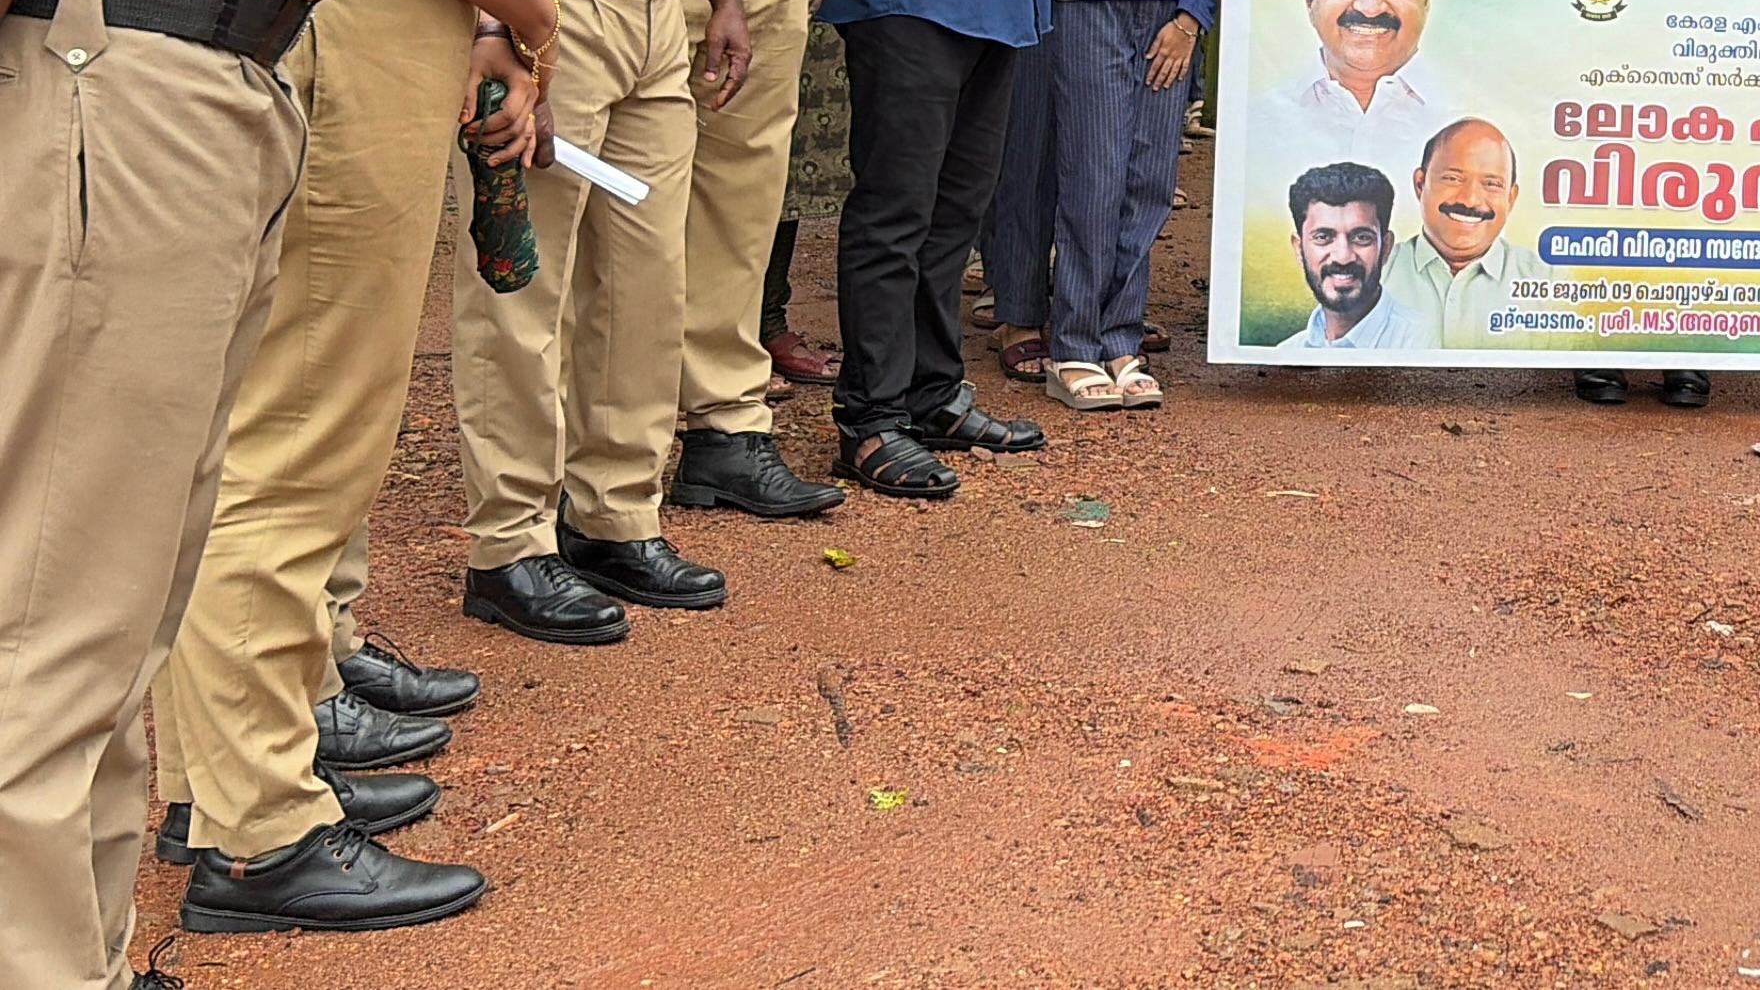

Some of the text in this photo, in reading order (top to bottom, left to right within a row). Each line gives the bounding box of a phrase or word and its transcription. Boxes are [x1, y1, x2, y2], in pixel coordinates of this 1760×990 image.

[1666, 14, 1727, 33] കേരള
[1553, 101, 1735, 142] ലോക
[1550, 229, 1619, 257] ലഹരി
[1622, 230, 1702, 263] വിരുദ്ധ
[1511, 281, 1549, 299] 2026
[1552, 279, 1608, 303] ജൂൺ
[1611, 283, 1632, 300] 09
[1635, 280, 1729, 307] ചൊവ്വാഴ്ച
[1642, 310, 1677, 331] M.S
